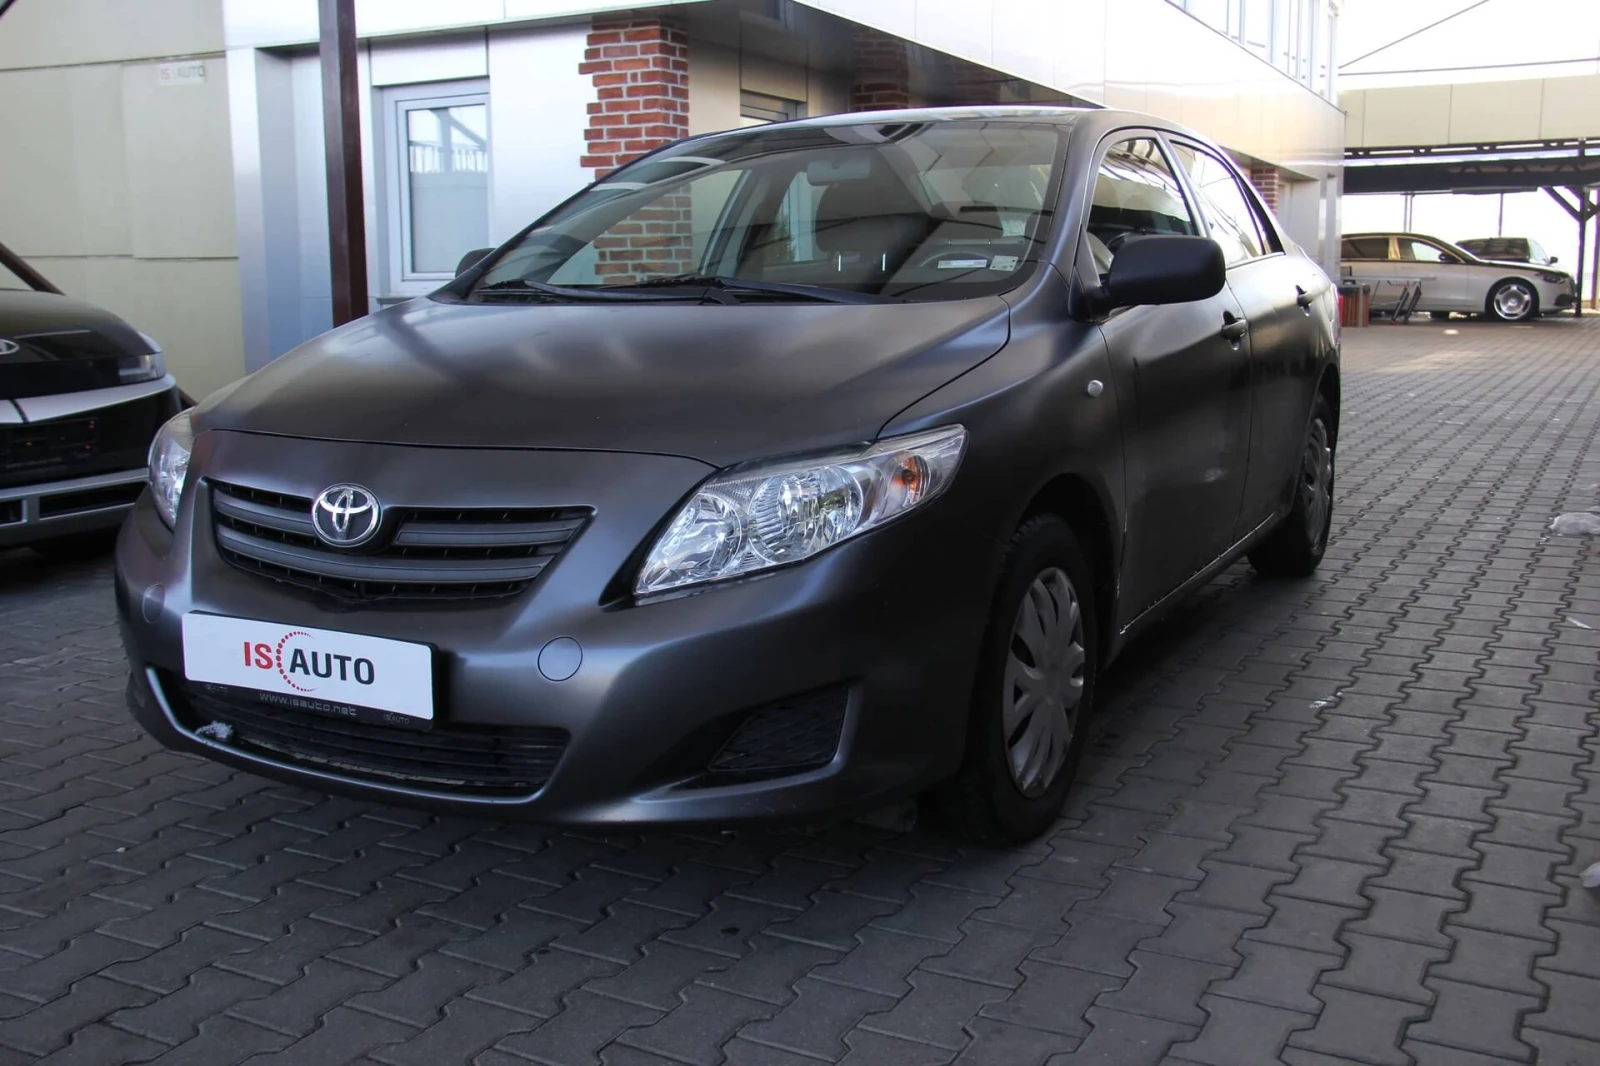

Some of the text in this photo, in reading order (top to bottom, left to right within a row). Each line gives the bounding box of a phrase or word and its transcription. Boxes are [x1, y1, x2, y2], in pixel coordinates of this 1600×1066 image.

[243, 641, 375, 685] IS AUTO
[259, 692, 357, 716] www.isauto.net
